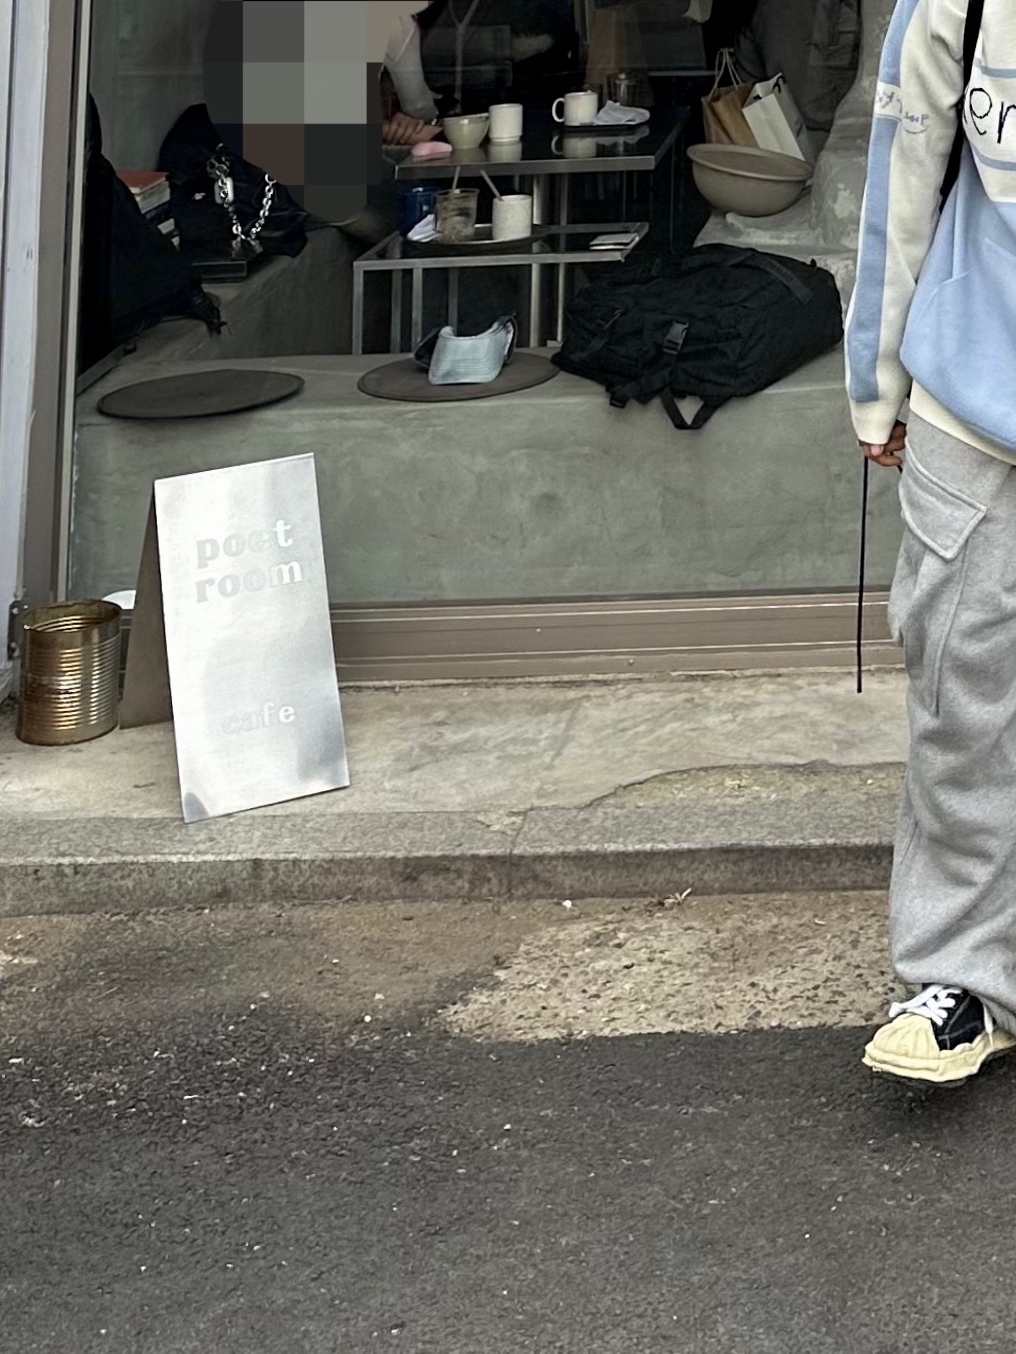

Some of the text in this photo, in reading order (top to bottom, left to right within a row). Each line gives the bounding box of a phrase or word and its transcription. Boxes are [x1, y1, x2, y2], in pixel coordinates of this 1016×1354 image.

[196, 519, 293, 569] poet
[195, 561, 302, 603] room
[221, 701, 296, 735] cafe
